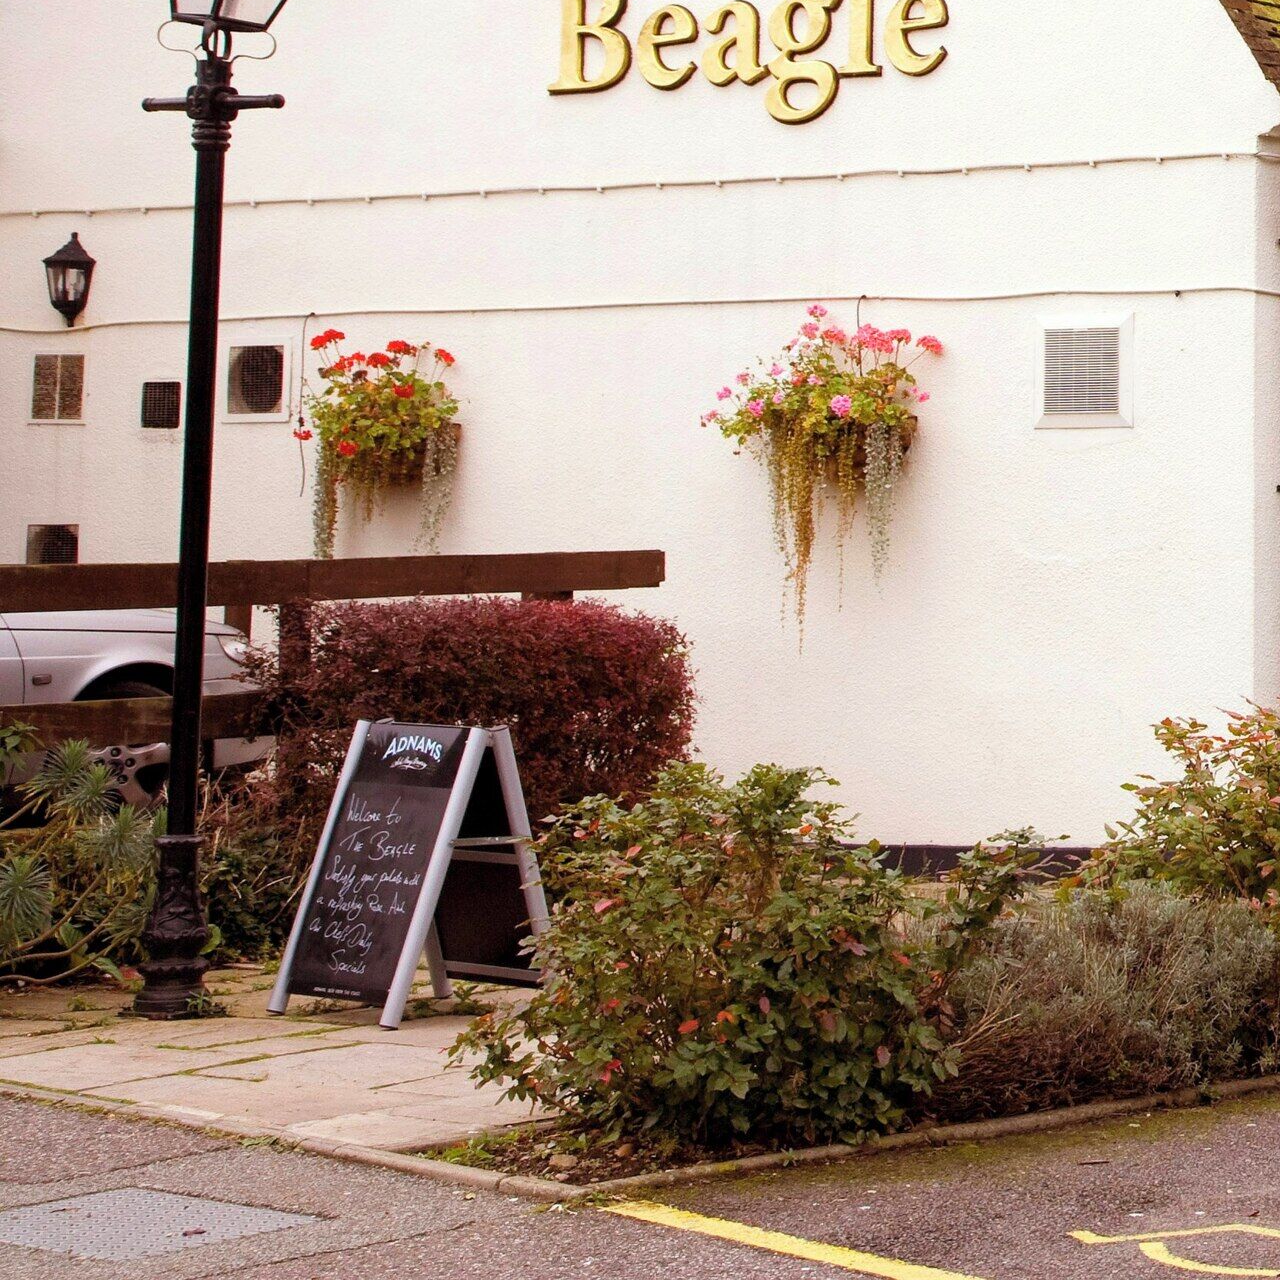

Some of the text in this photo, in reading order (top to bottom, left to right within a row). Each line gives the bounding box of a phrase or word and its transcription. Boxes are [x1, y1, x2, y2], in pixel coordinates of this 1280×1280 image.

[347, 793, 402, 825] Welcome to
[328, 949, 366, 976] Specials
